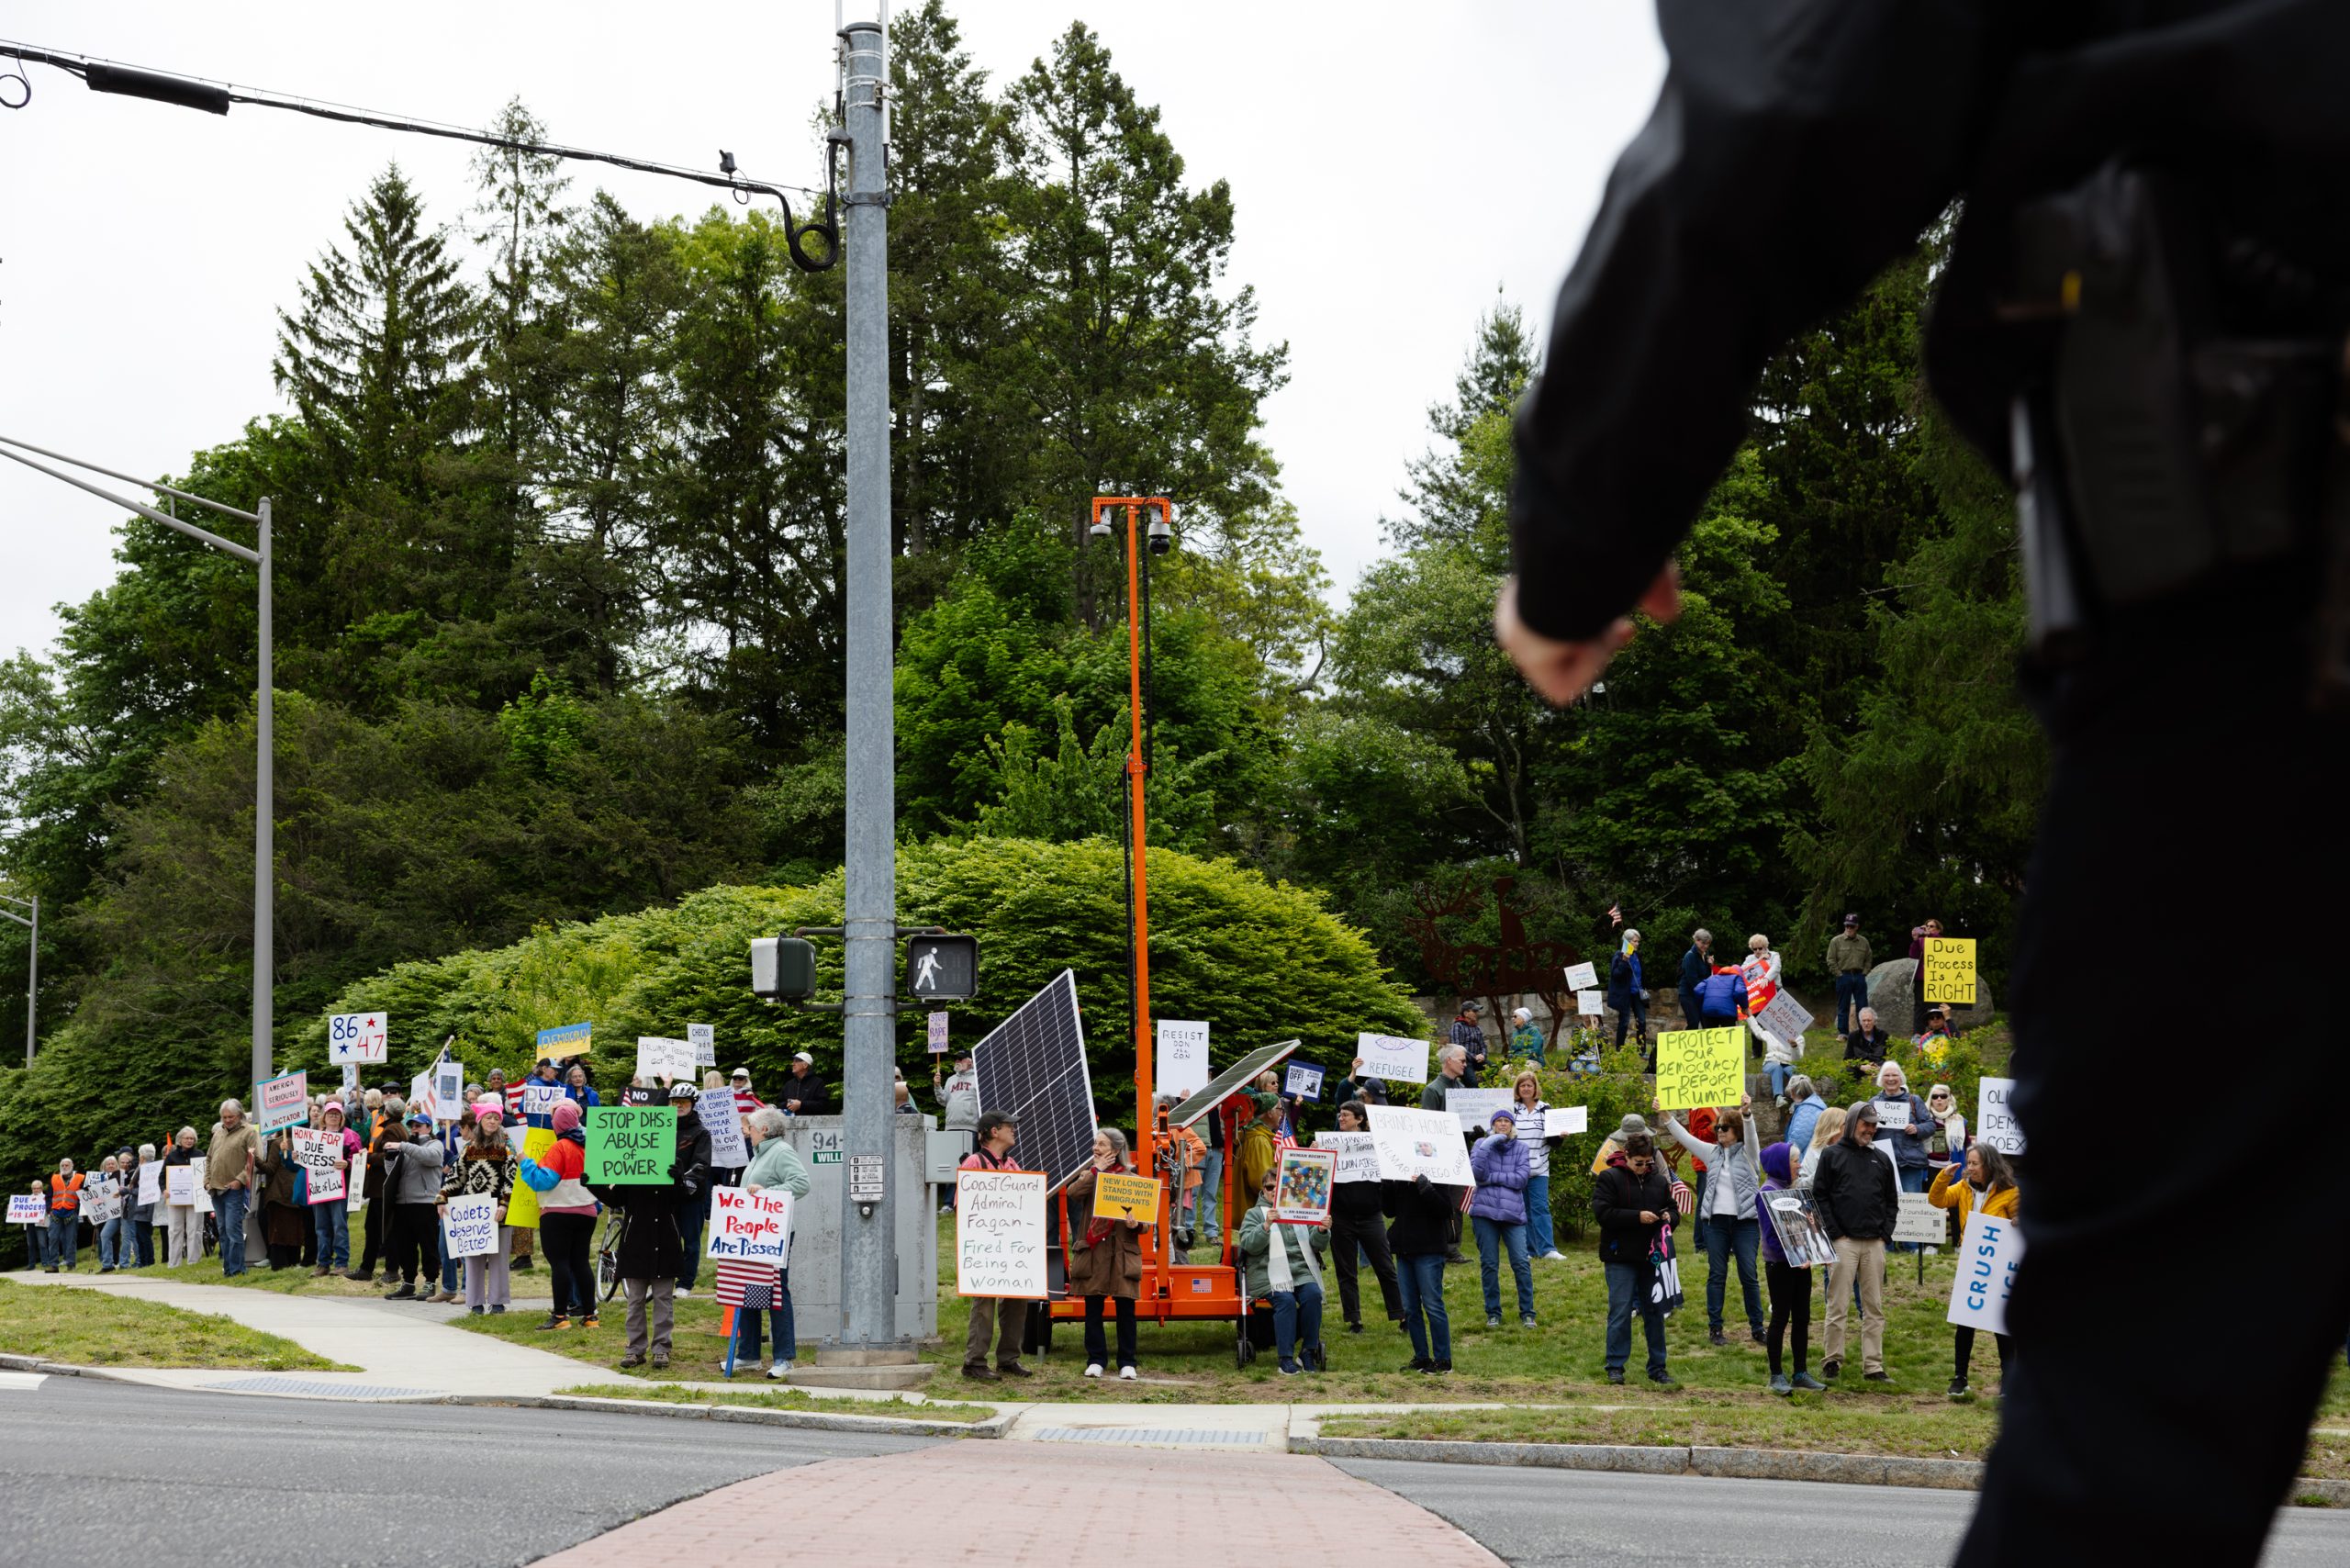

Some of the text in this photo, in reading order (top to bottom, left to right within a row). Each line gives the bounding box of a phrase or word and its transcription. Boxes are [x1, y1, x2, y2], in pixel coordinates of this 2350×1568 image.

[1933, 939, 1964, 953] Due
[1927, 954, 1974, 969] Process
[1930, 970, 1964, 981] Is A
[1926, 983, 1975, 1000] RIGHT
[1776, 992, 1809, 1024] Defend
[1777, 1006, 1796, 1024] DUE
[930, 1013, 947, 1022] STOP
[1765, 1006, 1797, 1037] PROCESS
[333, 1016, 358, 1040] 86
[691, 1028, 710, 1037] CHECKS
[929, 1026, 946, 1037] RAPE
[1162, 1029, 1203, 1041] RESIST
[357, 1035, 385, 1058] 47
[1666, 1028, 1735, 1051] PROTECT
[641, 1044, 694, 1058] TRUMP REGIME
[1683, 1047, 1715, 1062] OUR
[1369, 1061, 1415, 1078] REFUGEE
[1657, 1057, 1740, 1076] DEMOCRACY
[1289, 1072, 1304, 1081] OFF!
[1680, 1072, 1737, 1088] DEPORT
[268, 1080, 295, 1092] AMERICA
[950, 1081, 971, 1092] MIT
[524, 1087, 564, 1102] DUE
[632, 1091, 649, 1101] NO
[1662, 1086, 1737, 1105] TRUMP
[1987, 1089, 2009, 1104] OLI
[524, 1103, 551, 1114] PROC
[695, 1100, 730, 1111] EAS CORPUS
[1885, 1102, 1901, 1110] Due
[272, 1110, 305, 1126] DICTATOR?
[596, 1112, 673, 1129] STOP DHS's
[1374, 1113, 1454, 1136] BRING HOME
[1986, 1114, 2019, 1130] DEM
[293, 1128, 341, 1147] HONK FOR
[710, 1127, 731, 1136] EOPLE
[603, 1132, 660, 1149] ABUSE
[723, 1135, 740, 1144] OUR
[1987, 1136, 2027, 1151] COEX
[304, 1141, 324, 1154] DUE
[531, 1141, 551, 1159] FRE
[622, 1148, 637, 1160] of
[1345, 1145, 1350, 1153] A
[1353, 1144, 1375, 1152] THREA
[817, 1152, 844, 1163] WILLI
[1378, 1140, 1466, 1179] KILMAR ABREGO GARCIA
[602, 1159, 659, 1177] POWER
[1361, 1170, 1381, 1179] ARE
[1000, 1175, 1039, 1192] Guard
[1102, 1177, 1154, 1190] NEW LONDON
[82, 1185, 111, 1202] COLD AS
[1102, 1185, 1153, 1198] STANDS WITH
[718, 1193, 784, 1214] We The
[970, 1193, 1023, 1212] Admiral
[1102, 1194, 1150, 1206] IMMIGRANTS
[92, 1213, 108, 1223] KRISTI
[451, 1204, 491, 1223] Cadets
[1903, 1208, 1939, 1216] Foundation
[449, 1222, 491, 1238] deserve
[725, 1215, 779, 1240] People
[1893, 1230, 1936, 1239] oundation.org
[457, 1236, 492, 1253] Better
[711, 1236, 784, 1257] Are Pissed
[964, 1239, 1036, 1256] Fired For
[963, 1257, 1028, 1273] Being a
[1967, 1226, 2001, 1311] CRUSH
